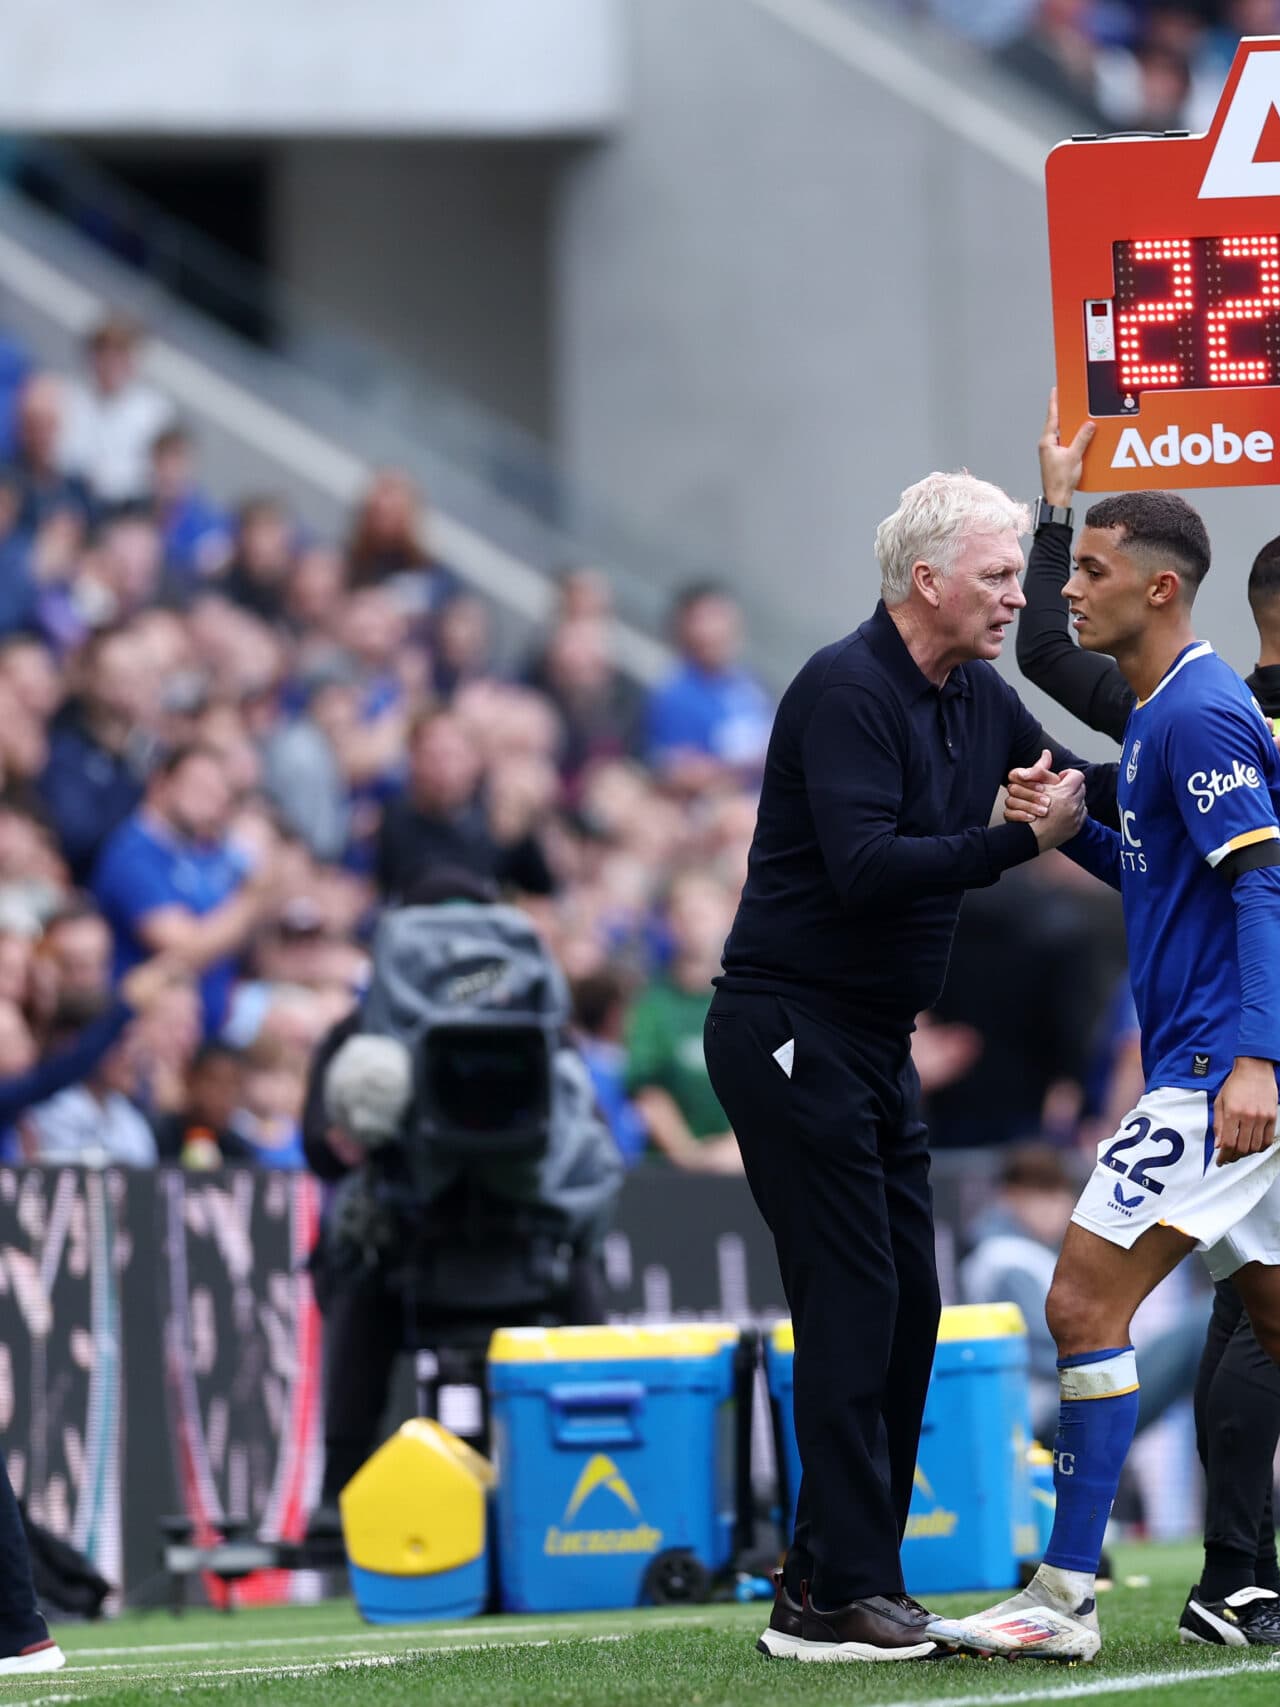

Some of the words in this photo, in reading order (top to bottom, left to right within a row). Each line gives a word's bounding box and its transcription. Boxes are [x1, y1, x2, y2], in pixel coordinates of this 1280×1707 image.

[1119, 236, 1280, 385] 22
[1110, 423, 1274, 469] Adobe
[1187, 760, 1260, 813] Stake
[1099, 1117, 1185, 1195] 22
